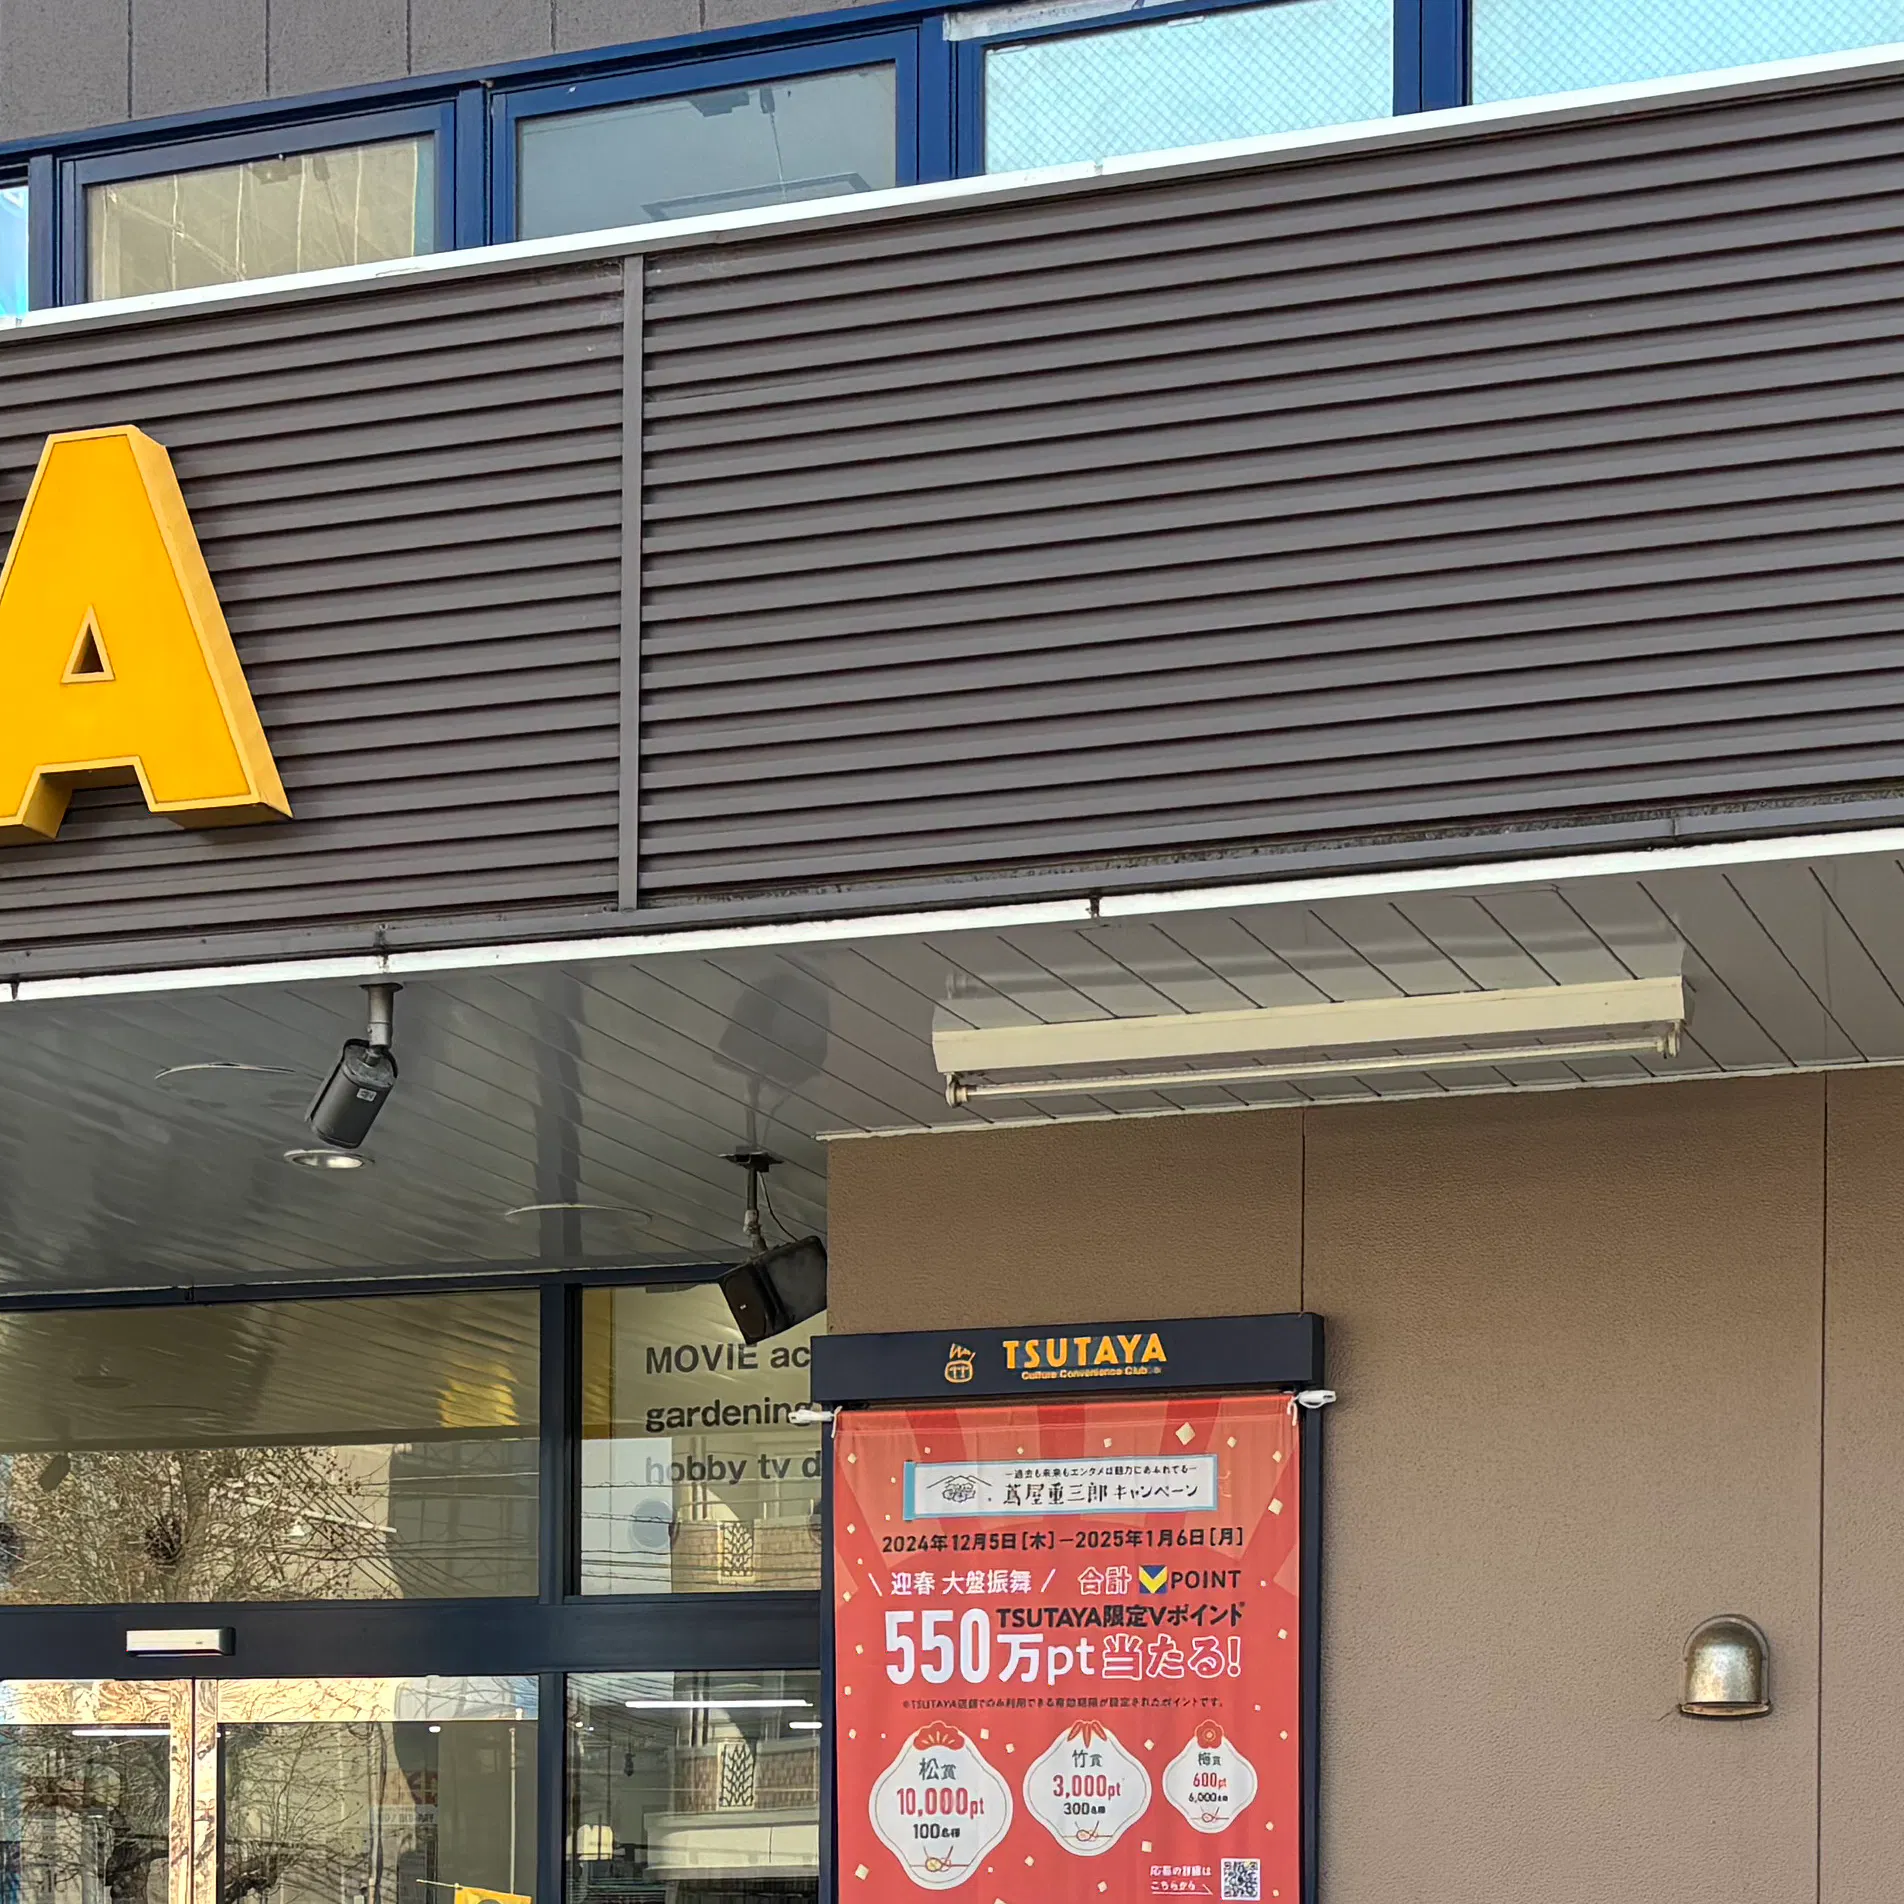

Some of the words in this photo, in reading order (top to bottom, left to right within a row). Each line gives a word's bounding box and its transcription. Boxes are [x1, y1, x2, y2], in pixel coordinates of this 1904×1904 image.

[645, 1342, 758, 1375] MOVIE
[1002, 1332, 1168, 1370] TSUTAYA
[645, 1454, 748, 1485] hobby
[758, 1454, 792, 1480] tv
[890, 1570, 935, 1596] 迎春
[941, 1568, 1032, 1596] 大盤振舞
[918, 1757, 958, 1782] 松賞
[1052, 1773, 1123, 1801] 3,000pt
[896, 1786, 986, 1820] 10,000pt
